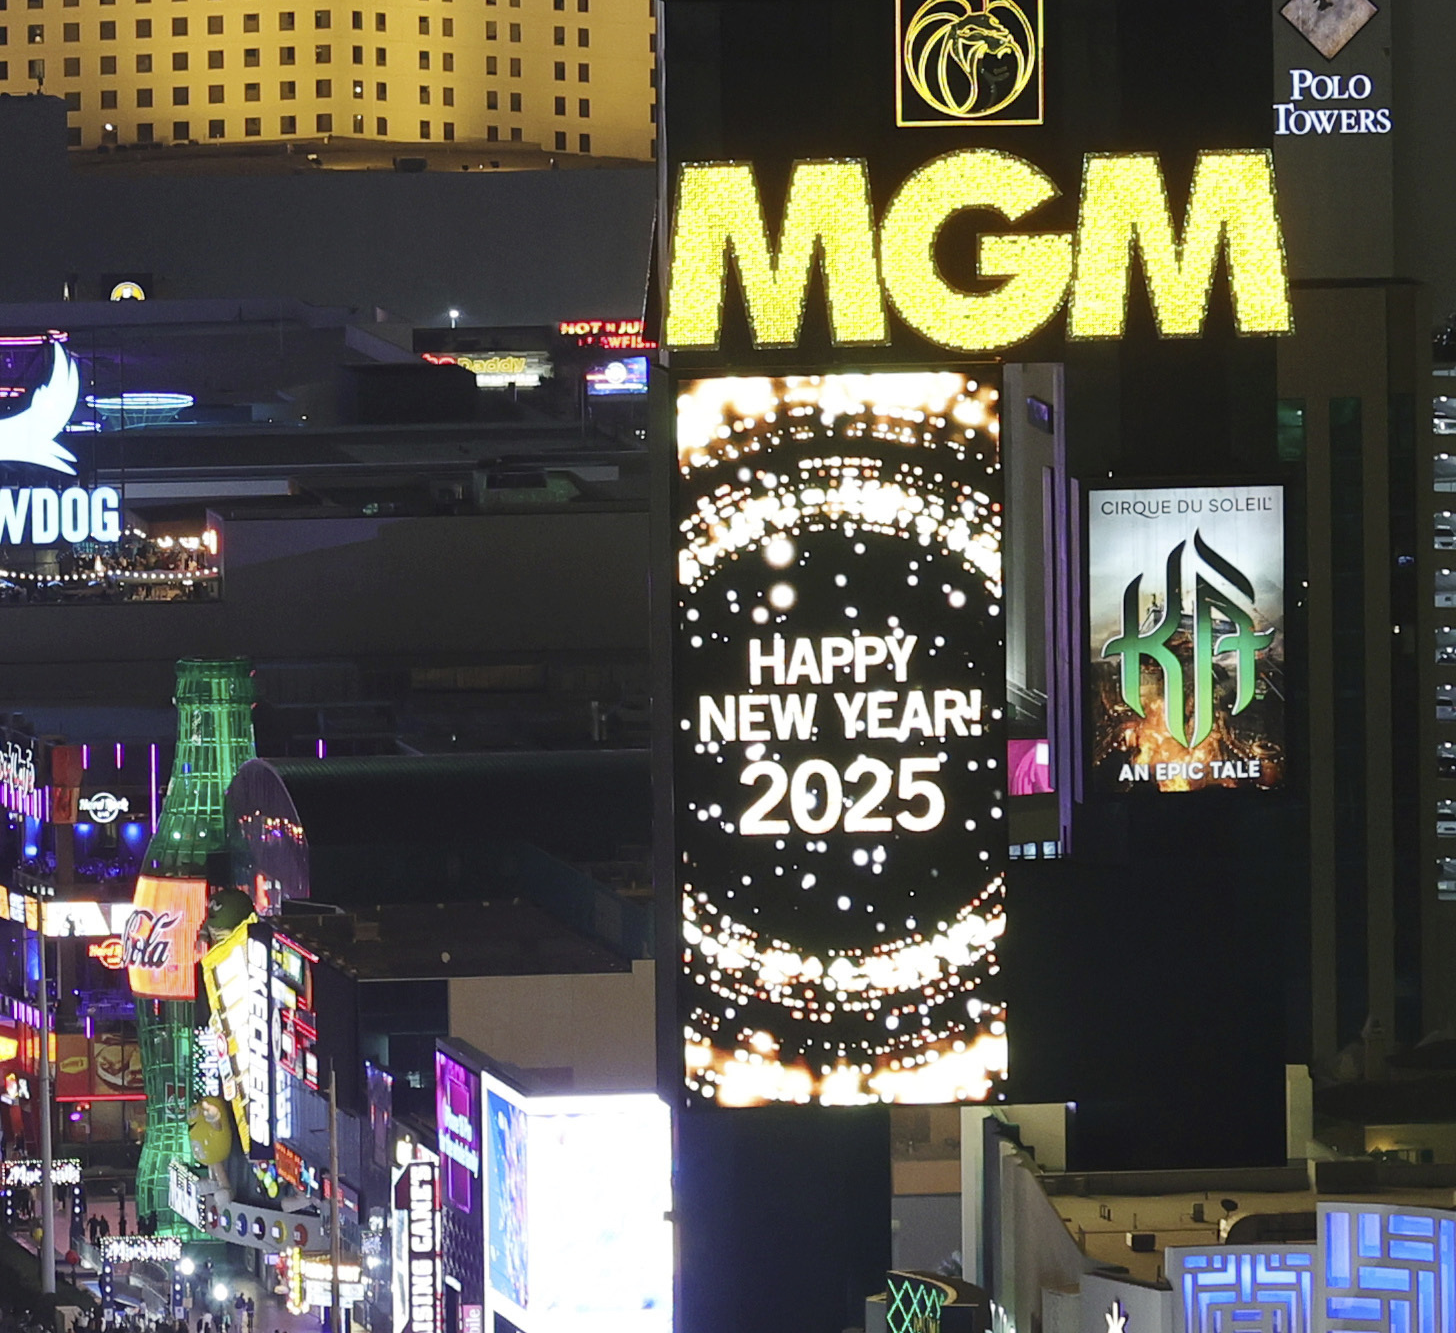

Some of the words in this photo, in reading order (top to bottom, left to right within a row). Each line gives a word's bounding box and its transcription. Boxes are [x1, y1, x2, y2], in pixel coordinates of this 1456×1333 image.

[664, 148, 1295, 353] MGM
[560, 321, 603, 335] HOT
[457, 357, 527, 374] Daddy
[1101, 500, 1171, 519] CIRQUE
[1177, 499, 1203, 514] DU
[1209, 497, 1273, 512] SOLEIL
[748, 635, 918, 687] HAPPY
[697, 693, 818, 743] NEW
[833, 688, 983, 741] YEAR!
[739, 756, 947, 837] 2025
[1118, 764, 1149, 781] AN
[1155, 761, 1204, 781] EPIC
[1209, 760, 1261, 779] TALE
[121, 909, 184, 971] Cola
[247, 937, 271, 1147] SKECHERS
[410, 1163, 434, 1253] CANE'S
